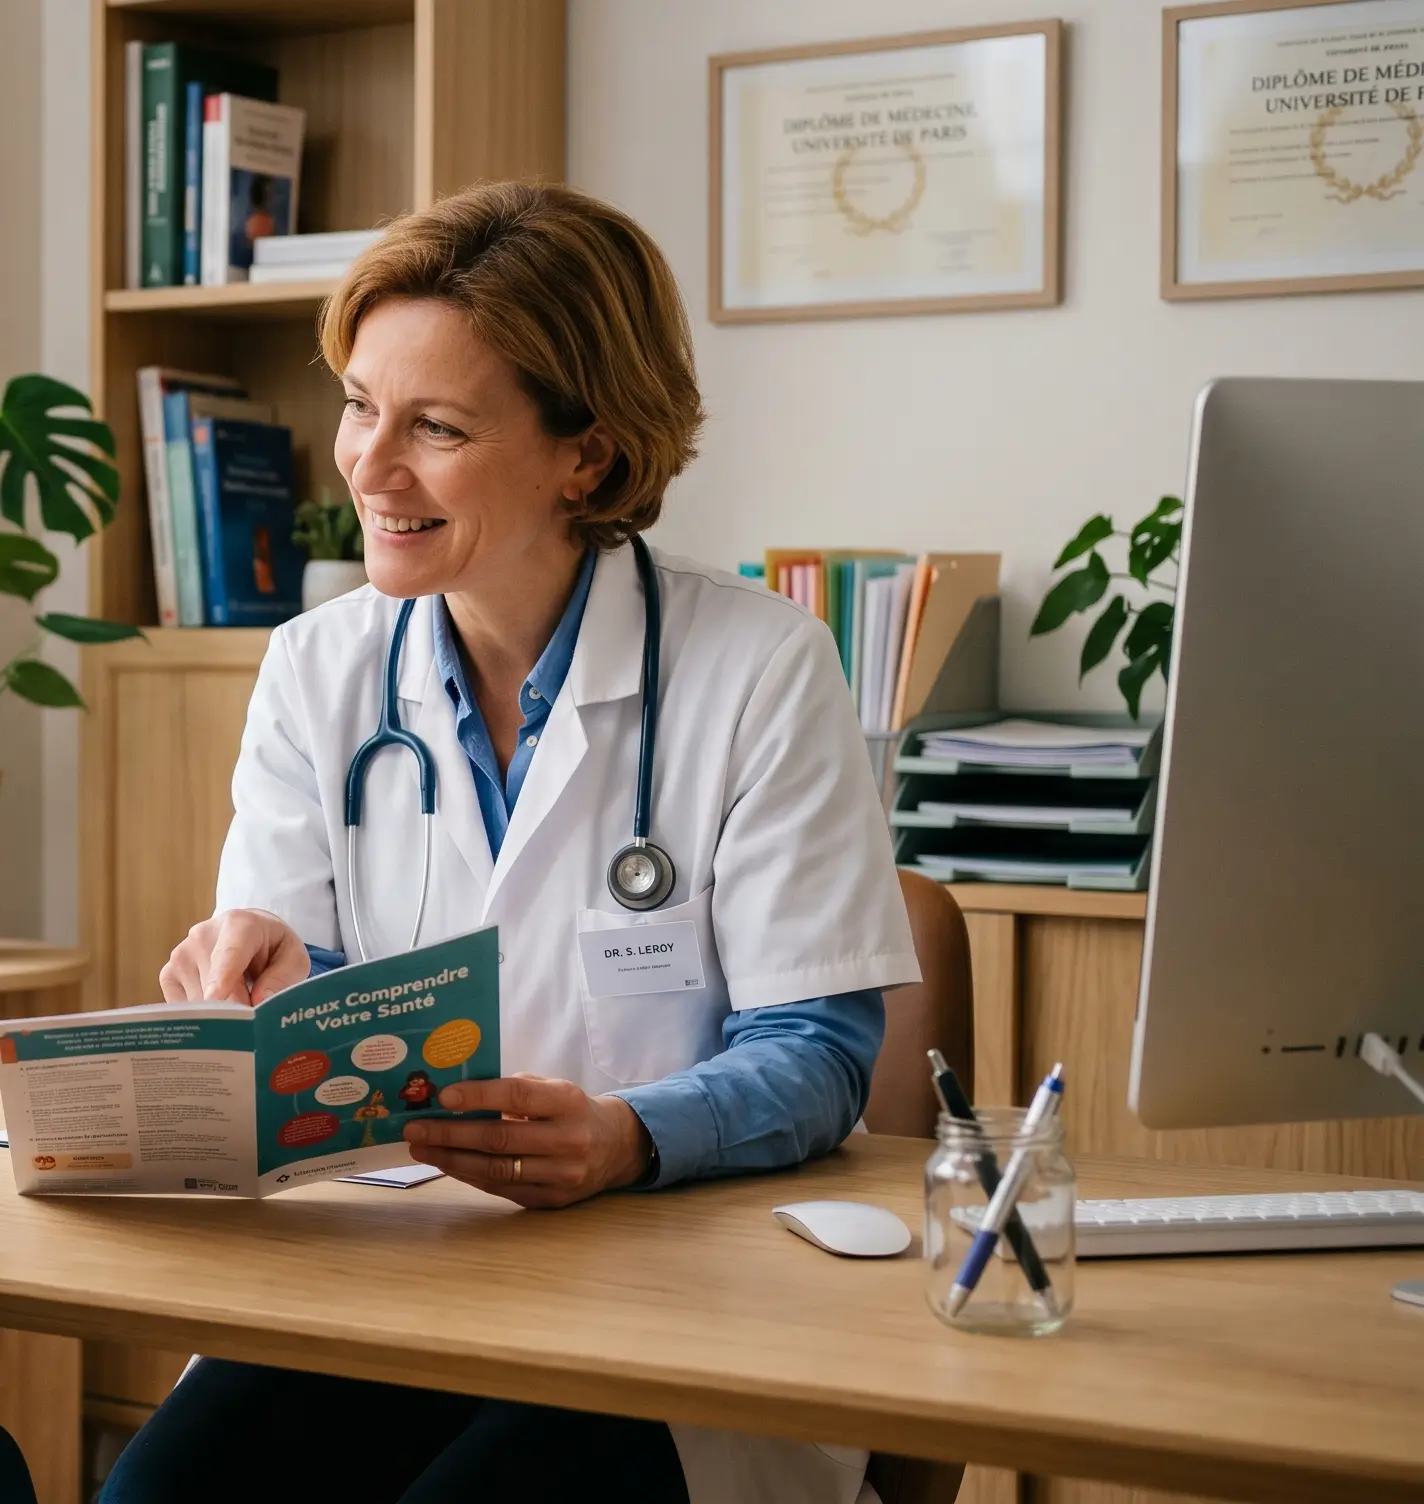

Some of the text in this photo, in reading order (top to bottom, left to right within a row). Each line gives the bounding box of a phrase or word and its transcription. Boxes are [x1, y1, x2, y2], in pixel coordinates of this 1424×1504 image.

[1252, 59, 1424, 93] DIPLÔME DE MÉD
[1266, 84, 1379, 114] UNIVERSITÉ
[1385, 86, 1411, 103] DE
[860, 110, 880, 127] DE
[893, 129, 913, 145] DE
[920, 124, 967, 142] PARIS
[604, 943, 674, 958] DR. S. LEROY
[280, 966, 469, 1028] Mieux Comprendre
[316, 993, 436, 1031] Votre Santé
